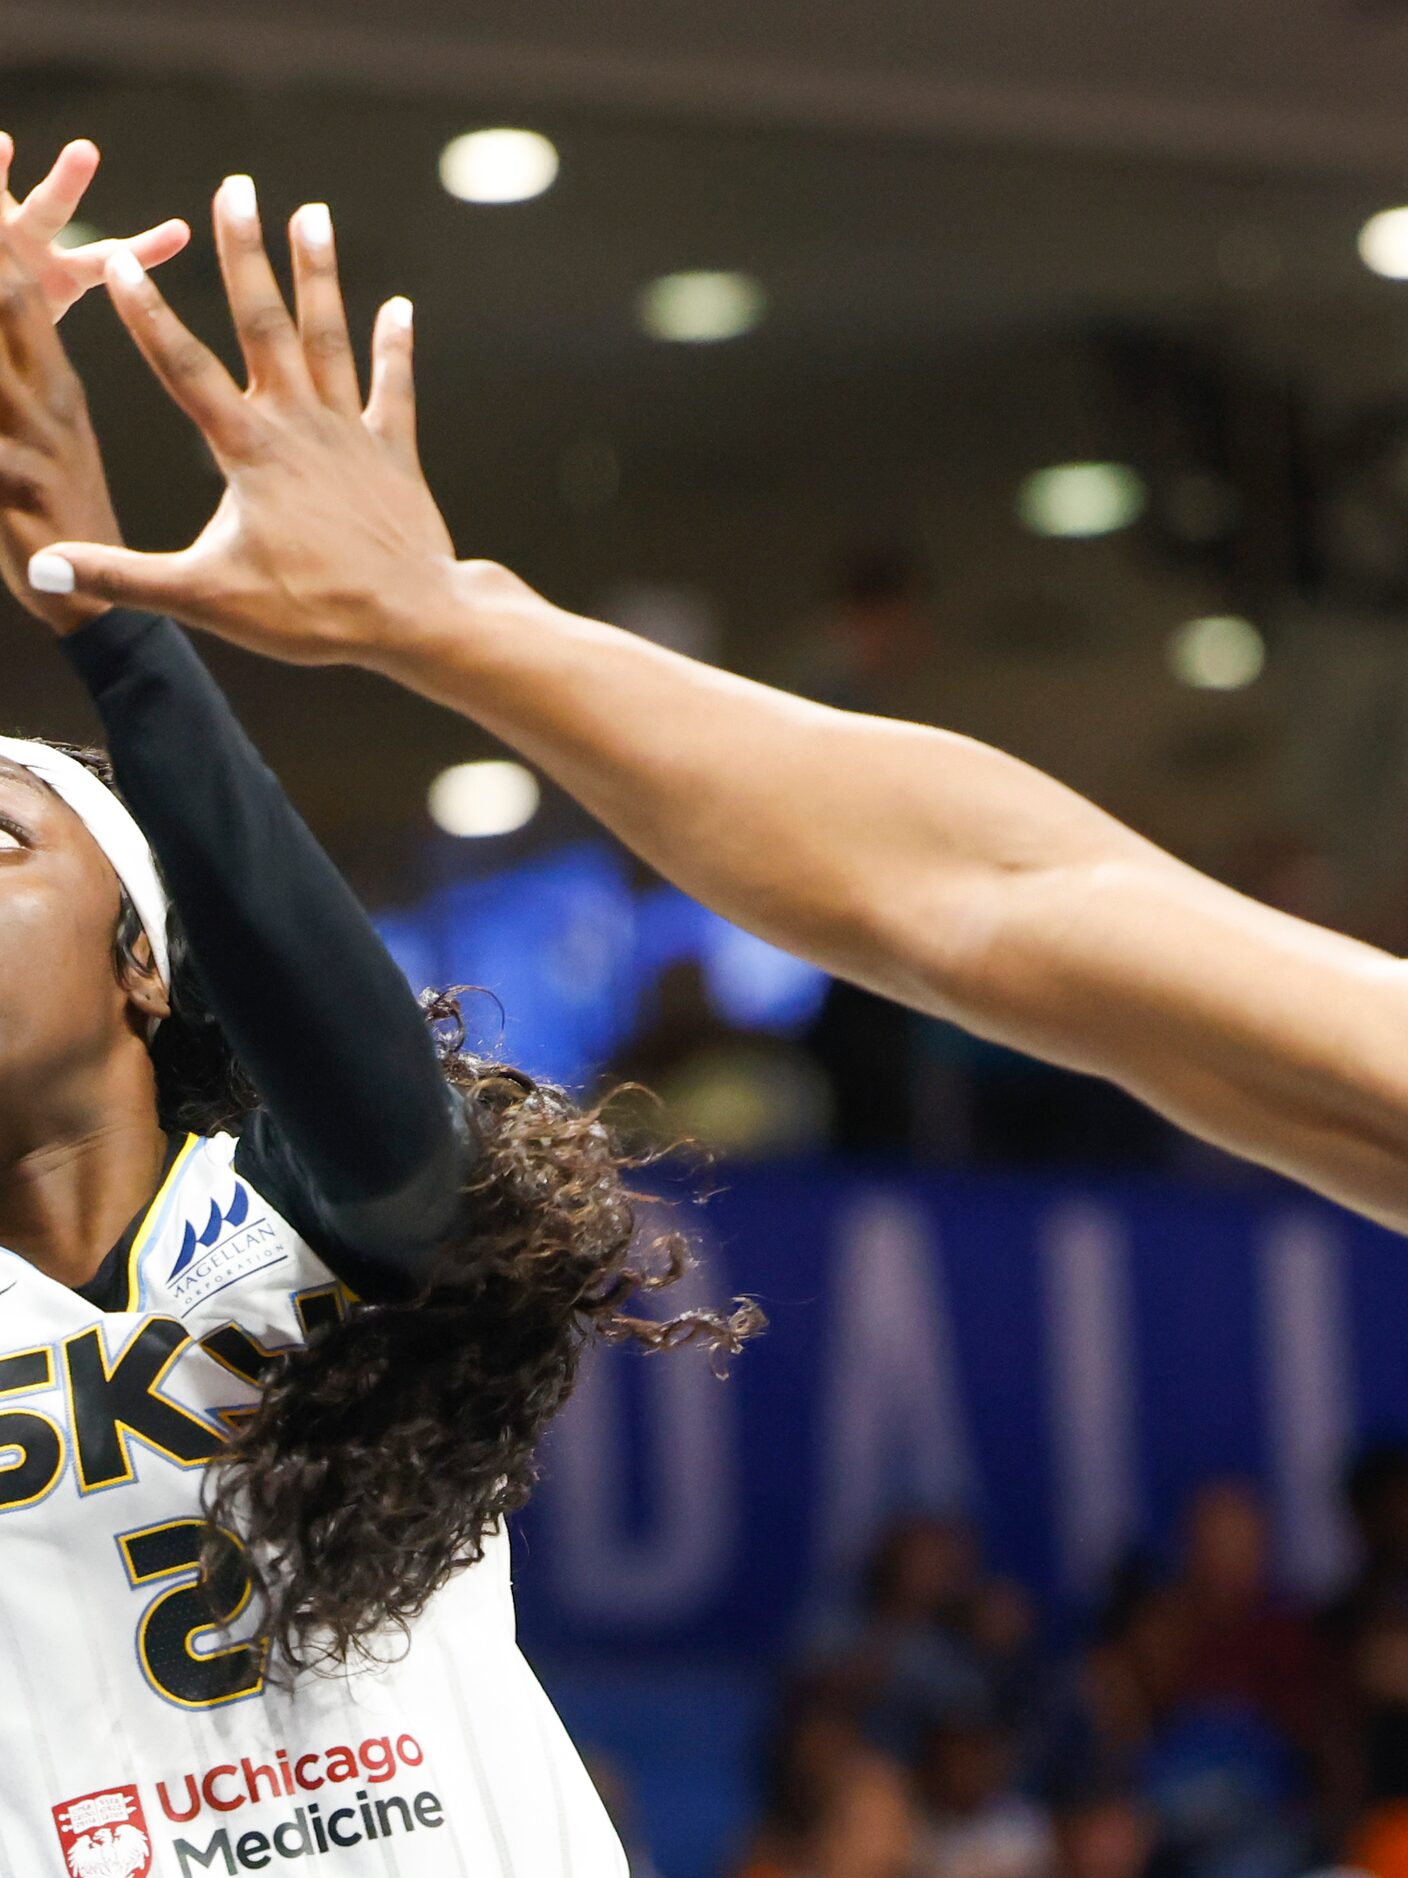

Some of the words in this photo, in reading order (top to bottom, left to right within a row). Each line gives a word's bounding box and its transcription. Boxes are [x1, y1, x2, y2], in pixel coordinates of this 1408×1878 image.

[173, 1223, 276, 1298] MAGELLAN
[184, 1243, 285, 1305] ORPORATION
[114, 1516, 274, 1712] 2
[155, 1733, 424, 1824] UChicago
[172, 1790, 445, 1877] Medicine
